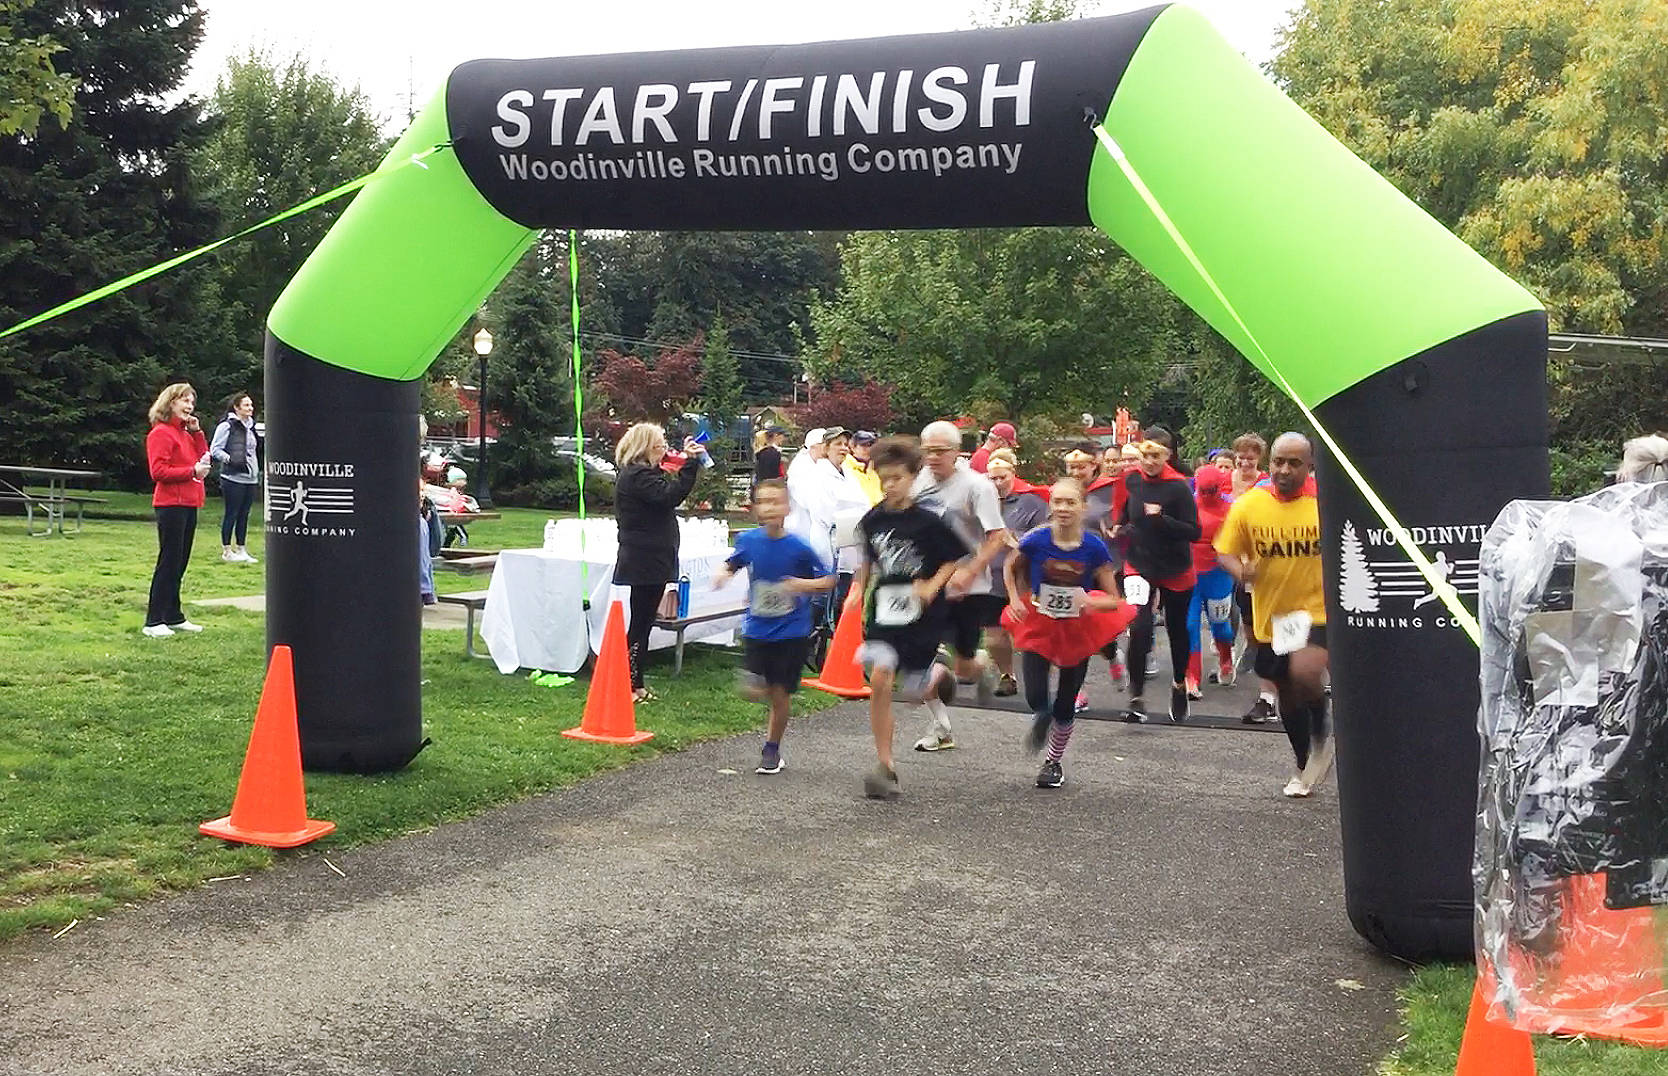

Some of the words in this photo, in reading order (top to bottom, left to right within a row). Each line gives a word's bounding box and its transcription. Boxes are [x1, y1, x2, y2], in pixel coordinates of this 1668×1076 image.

[490, 60, 1037, 148] START/FINISH
[499, 150, 686, 182] Woodinville
[694, 145, 840, 182] Running
[847, 139, 1023, 175] Company
[294, 526, 356, 537] COMPANY
[1047, 594, 1073, 610] 285
[1347, 615, 1423, 628] RUNNING
